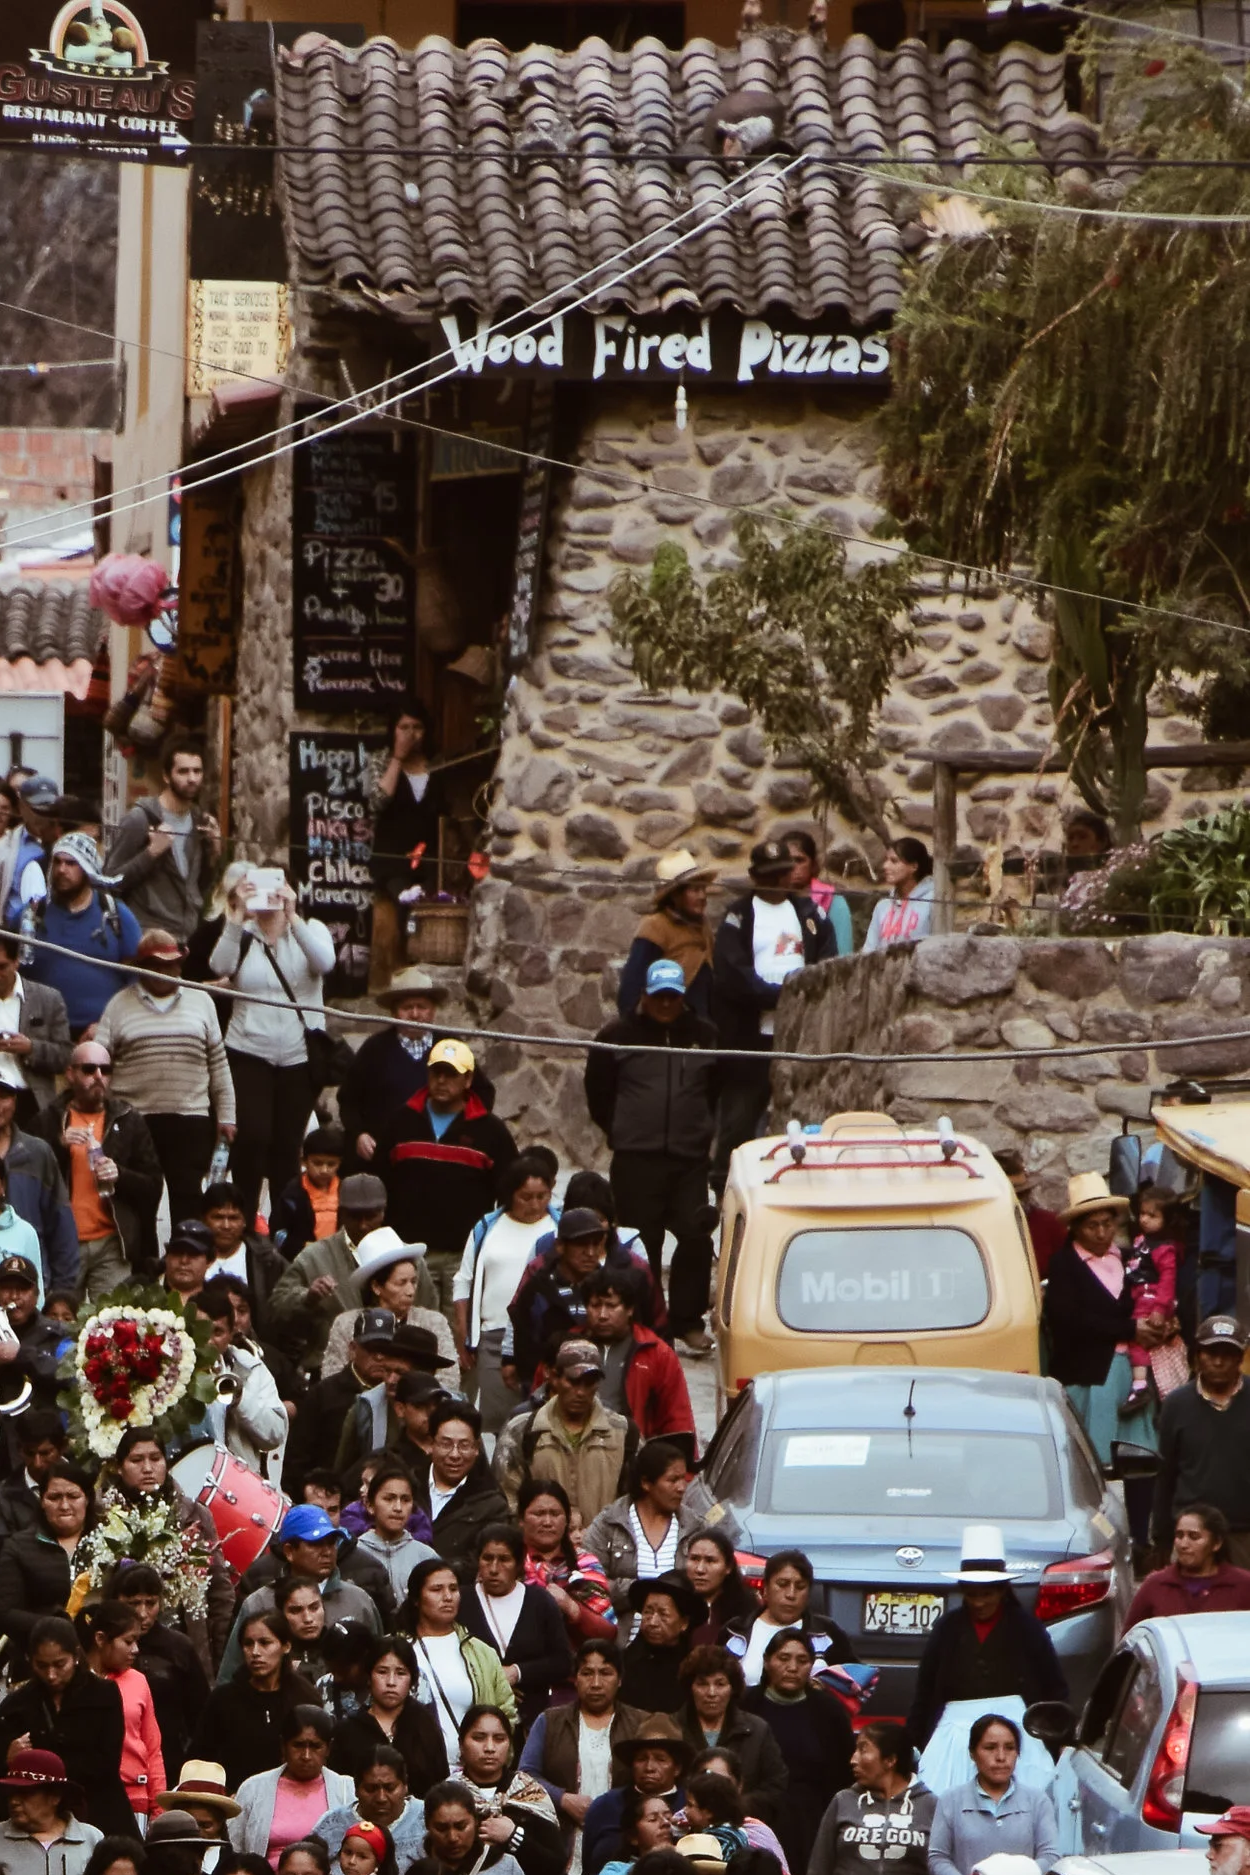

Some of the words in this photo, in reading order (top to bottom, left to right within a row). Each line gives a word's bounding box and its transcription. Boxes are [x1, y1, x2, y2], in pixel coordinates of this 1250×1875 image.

[2, 104, 107, 129] RESTAURANT
[440, 315, 564, 374] Wood
[592, 317, 714, 380] Fired
[738, 319, 891, 382] Pizzas
[374, 572, 406, 603] 30
[300, 740, 356, 773] Happy
[304, 791, 366, 819] Pisco
[801, 1270, 910, 1304] Mobil
[927, 1271, 942, 1298] 1
[867, 1602, 943, 1628] X3E-102
[843, 1826, 926, 1847] OREGON
